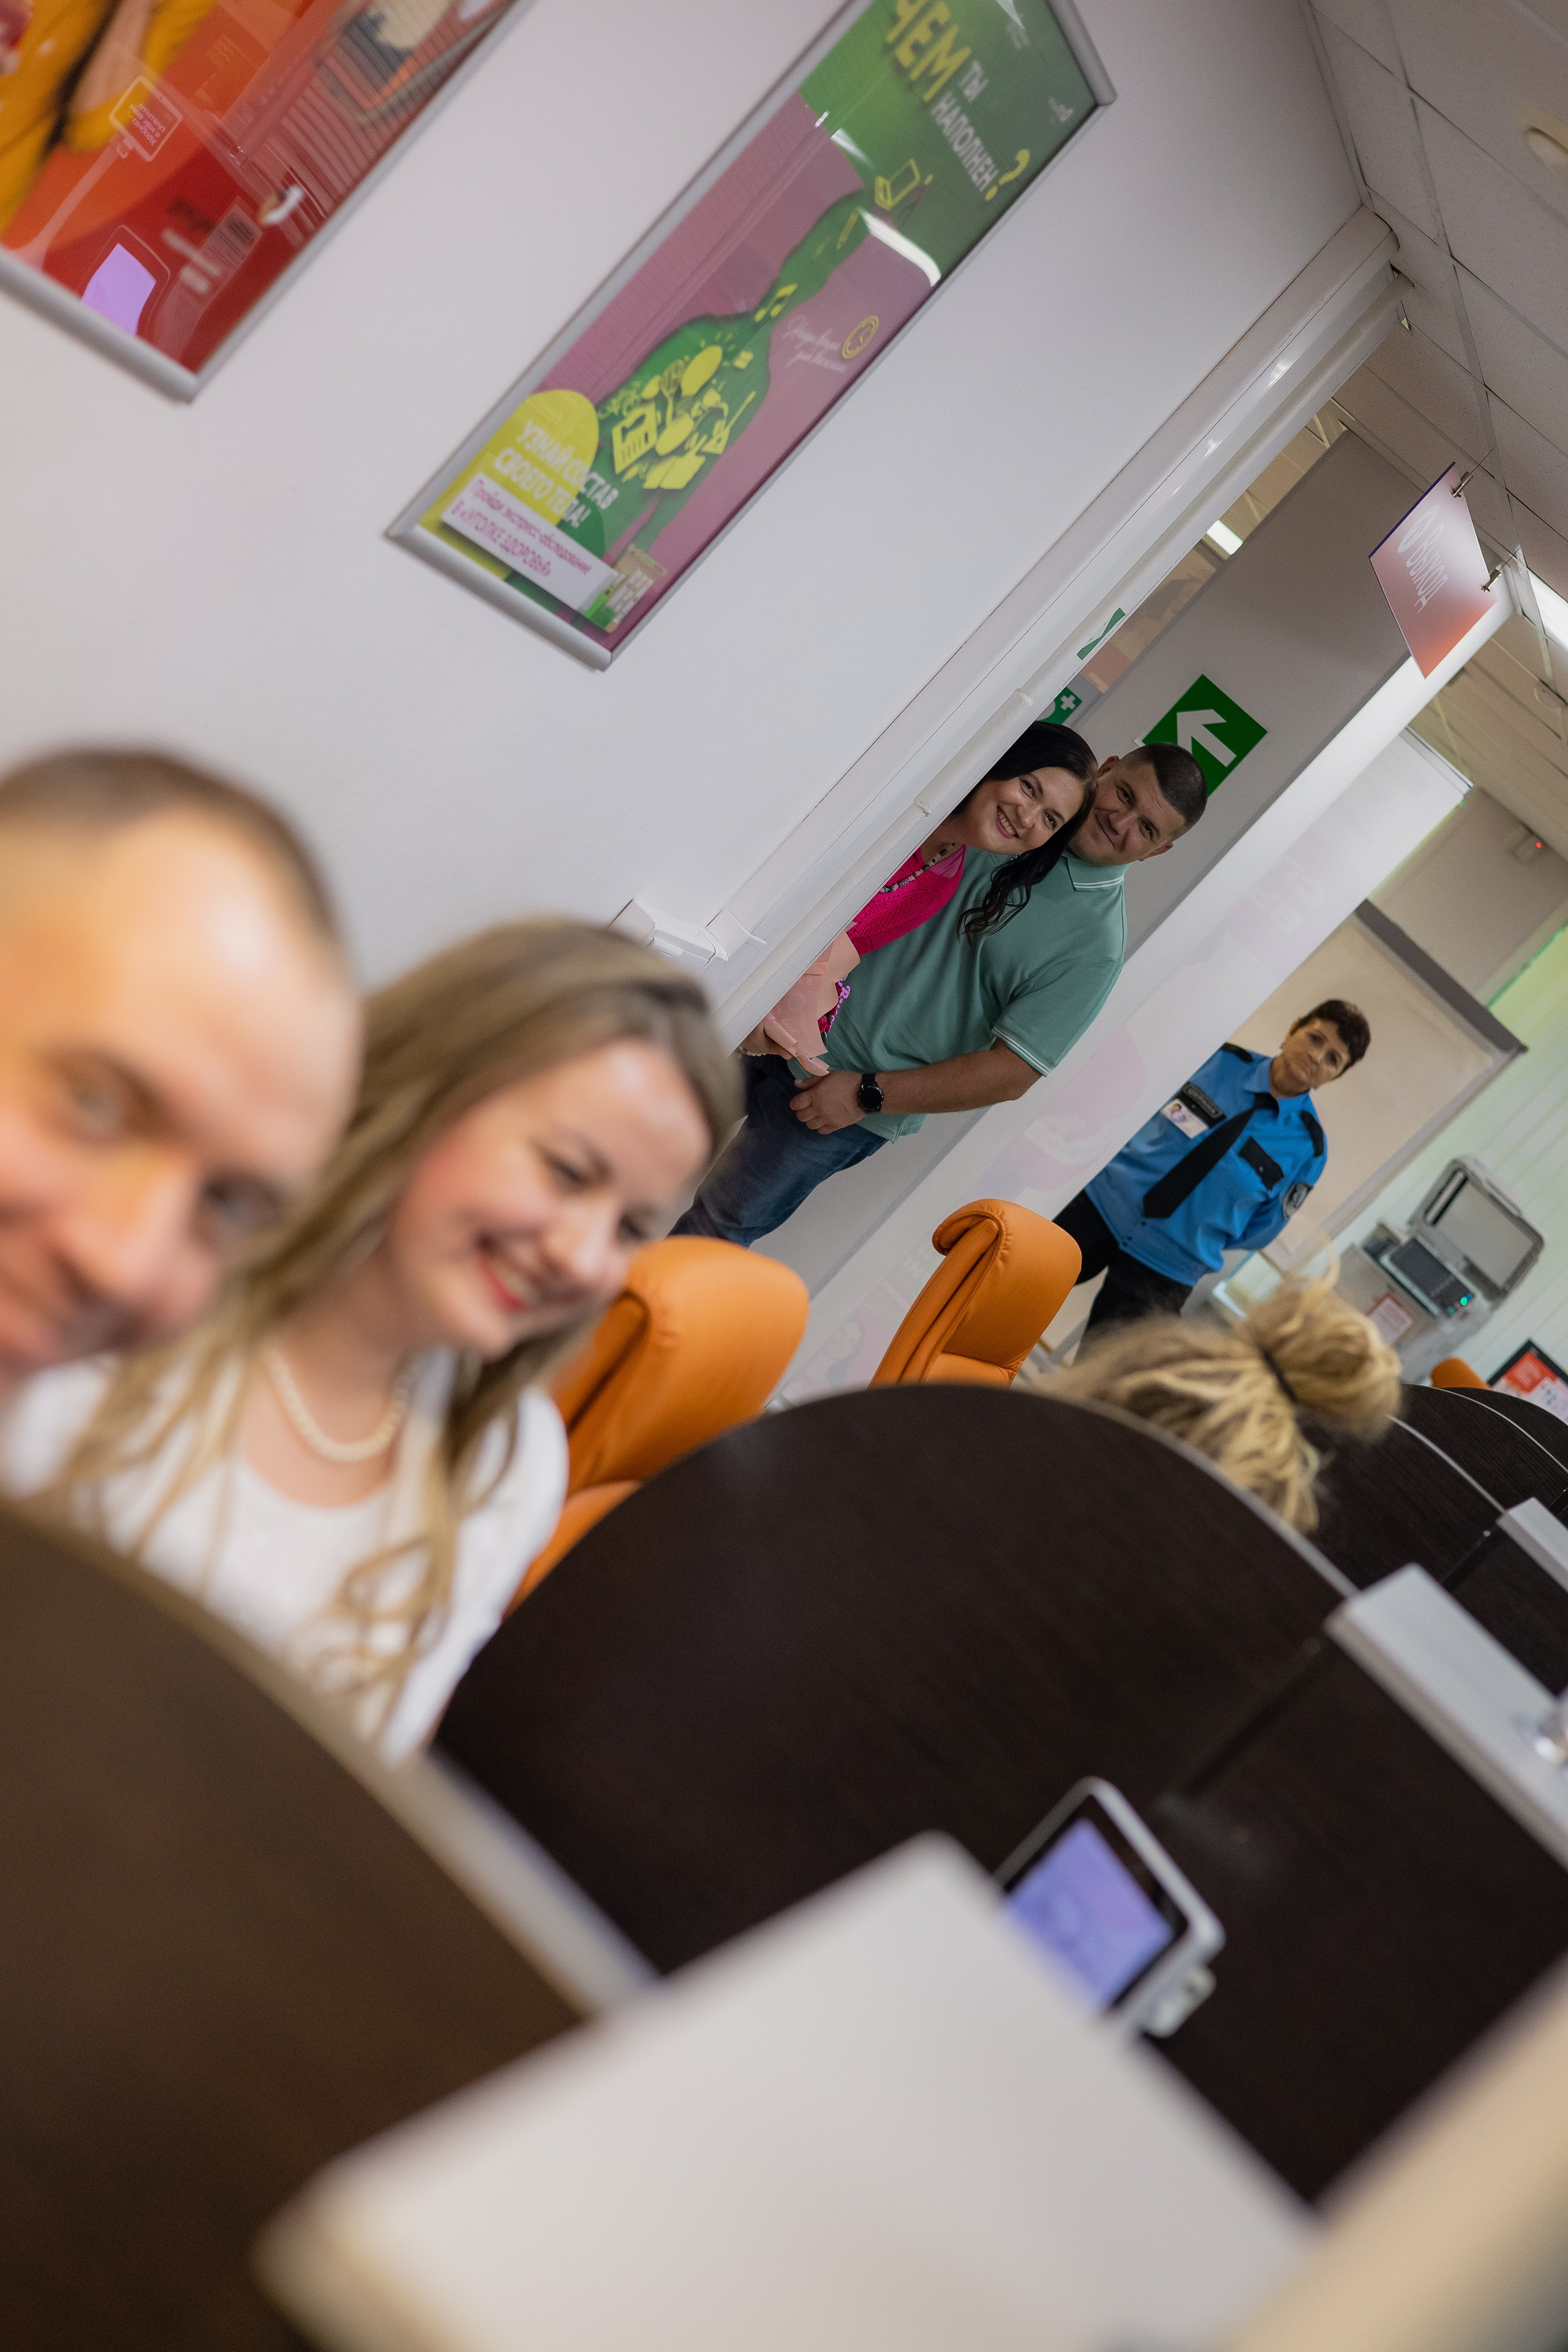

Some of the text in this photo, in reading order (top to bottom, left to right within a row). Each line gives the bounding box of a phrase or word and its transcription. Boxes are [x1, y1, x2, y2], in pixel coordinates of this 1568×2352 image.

[887, 0, 972, 102] ЧЕМ
[957, 60, 990, 103] ТЫ
[494, 448, 592, 529] СВОЕГО ТЕЛА!
[516, 420, 619, 510] УЗНАЙ СОСТАВ
